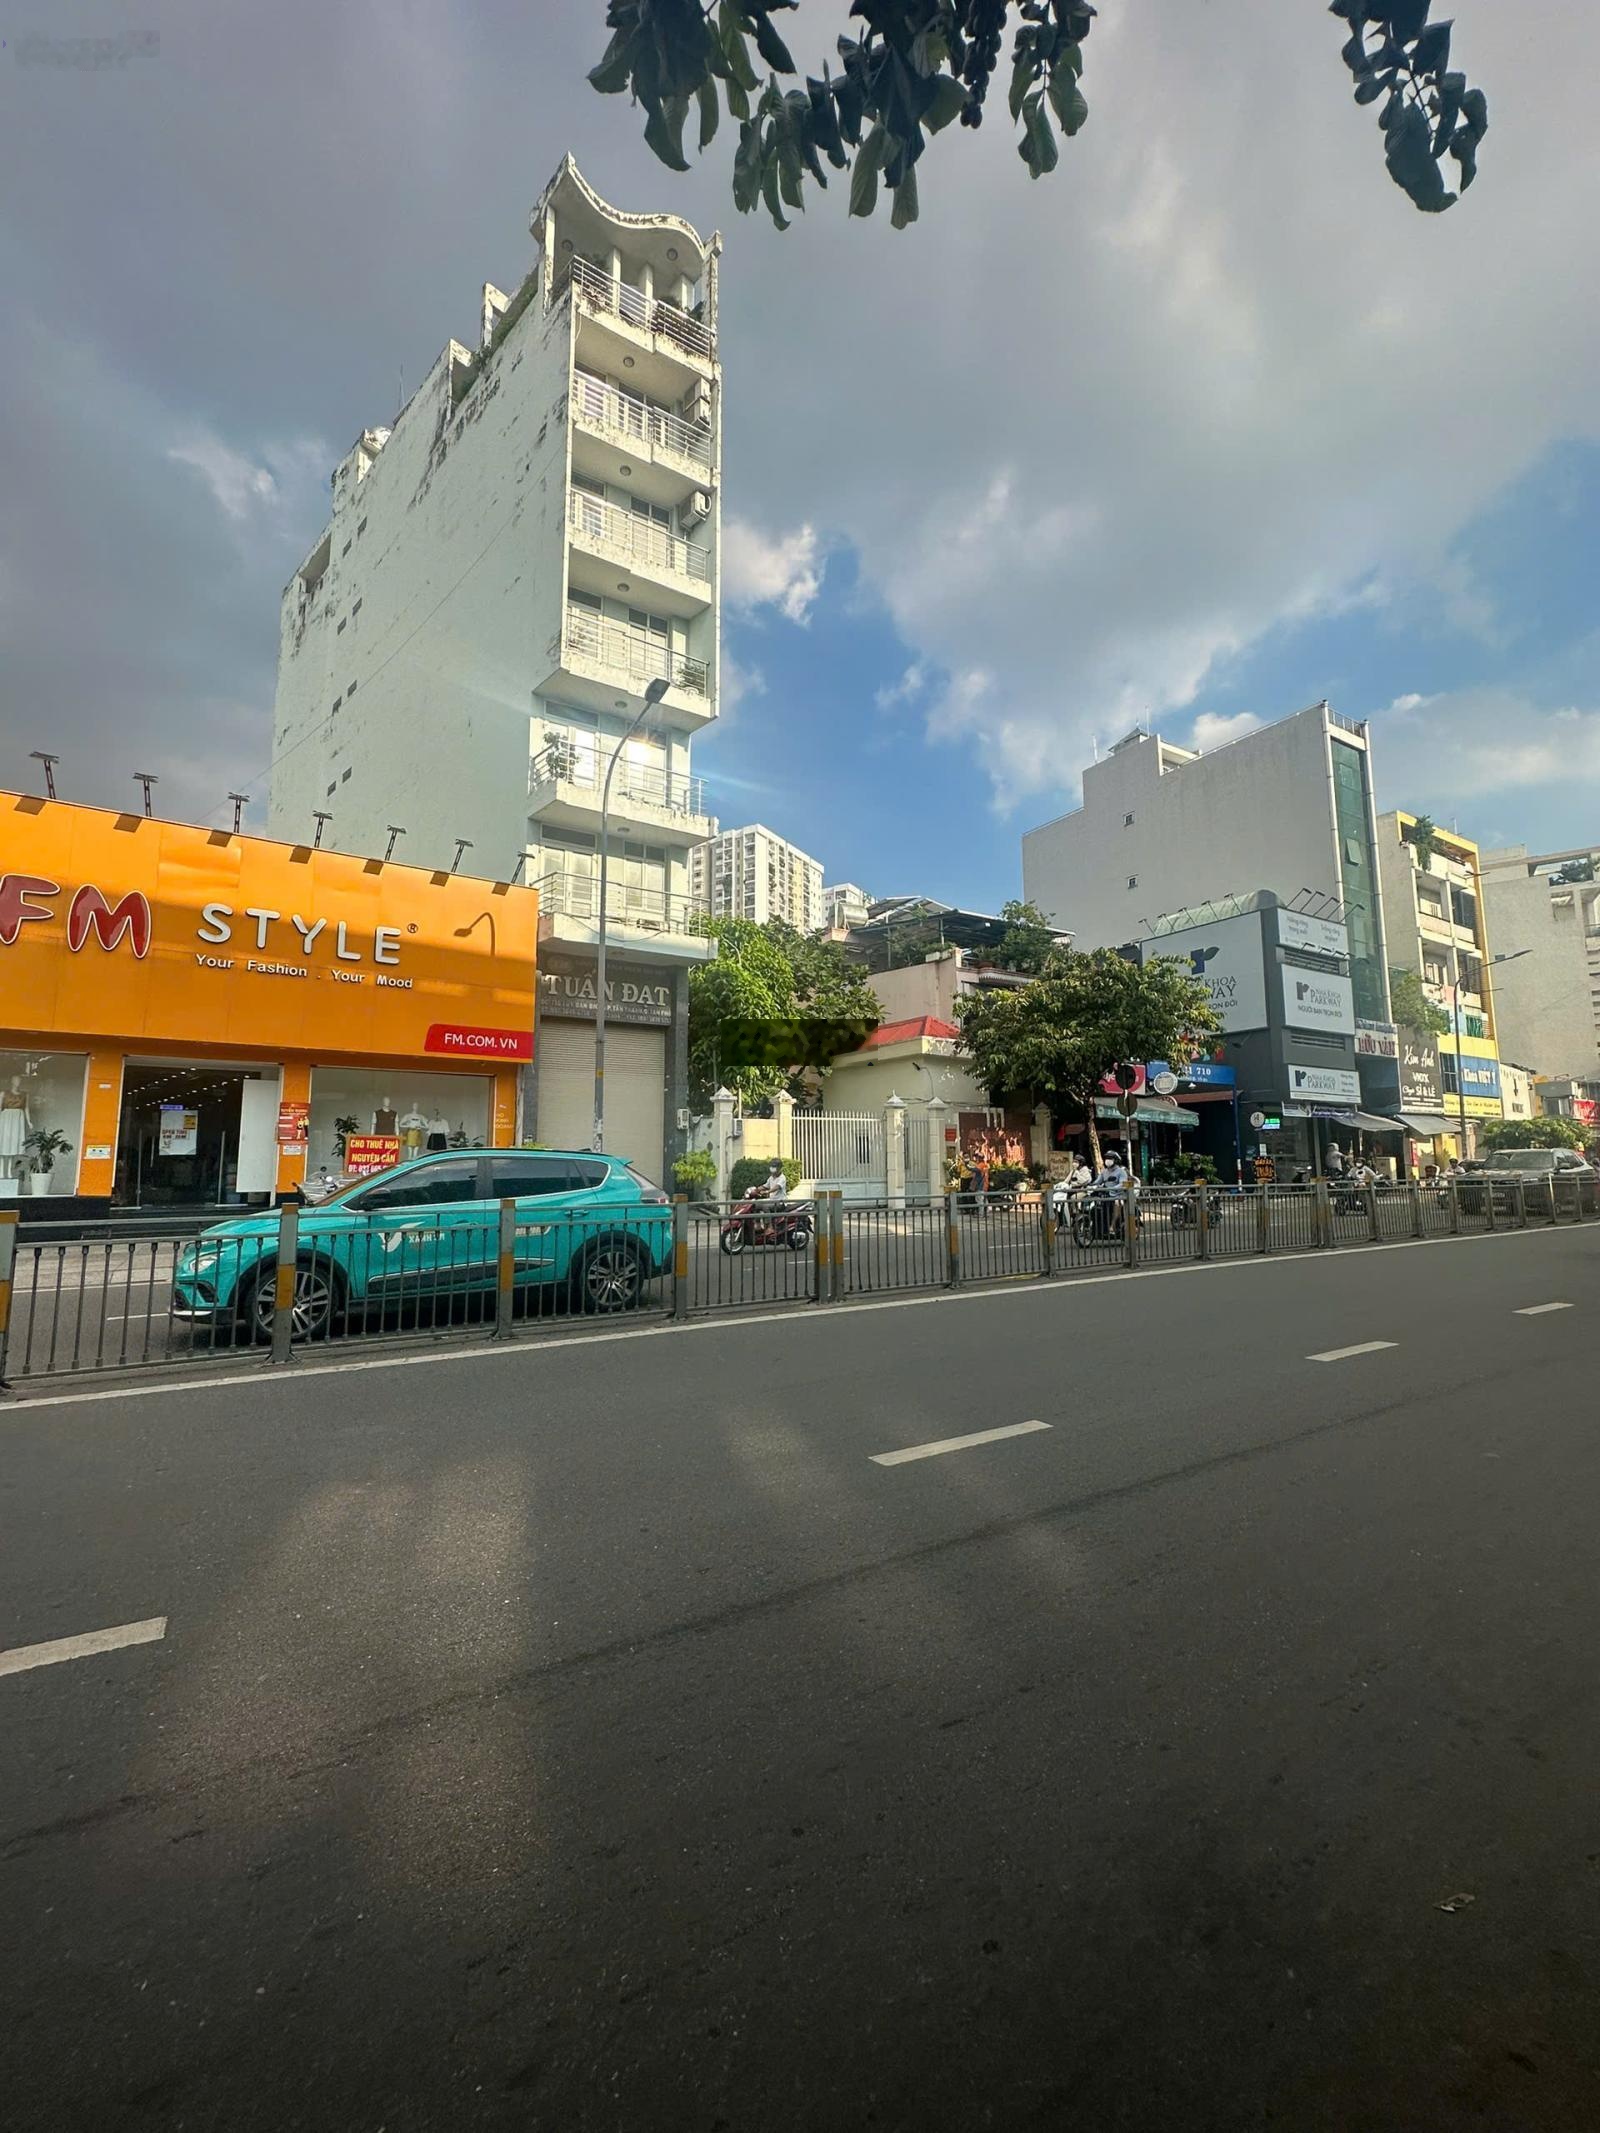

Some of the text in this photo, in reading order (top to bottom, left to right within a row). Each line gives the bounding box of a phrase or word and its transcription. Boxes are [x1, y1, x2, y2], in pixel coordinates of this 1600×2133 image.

[0, 873, 151, 959] FM
[197, 903, 402, 965] STYLE
[196, 954, 413, 989] Your Fashion Your Mood
[621, 982, 670, 1008] ĐẠT
[1310, 989, 1342, 1007] PARKWAY
[1307, 1075, 1337, 1090] PARKWAY
[350, 1139, 365, 1149] CHO
